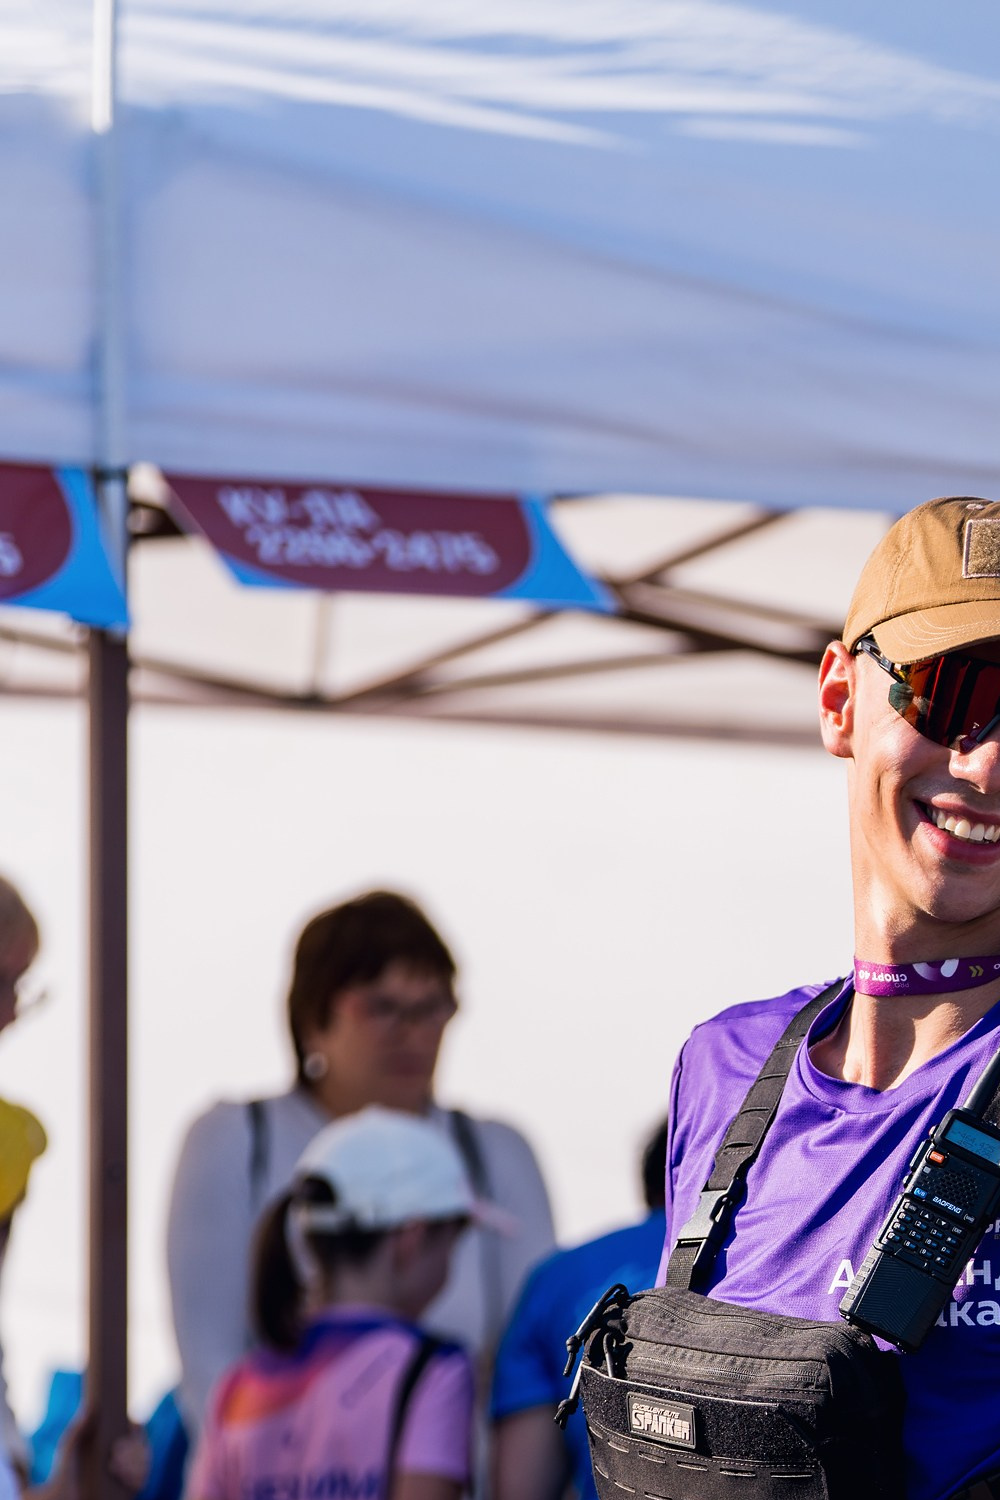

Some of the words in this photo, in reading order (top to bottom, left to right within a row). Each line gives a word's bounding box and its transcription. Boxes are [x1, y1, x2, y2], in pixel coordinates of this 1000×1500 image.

[858, 969, 870, 980] 40
[872, 970, 907, 982] СПОРТ
[932, 1196, 962, 1214] BAOFENG
[632, 1409, 690, 1440] SPANKER
